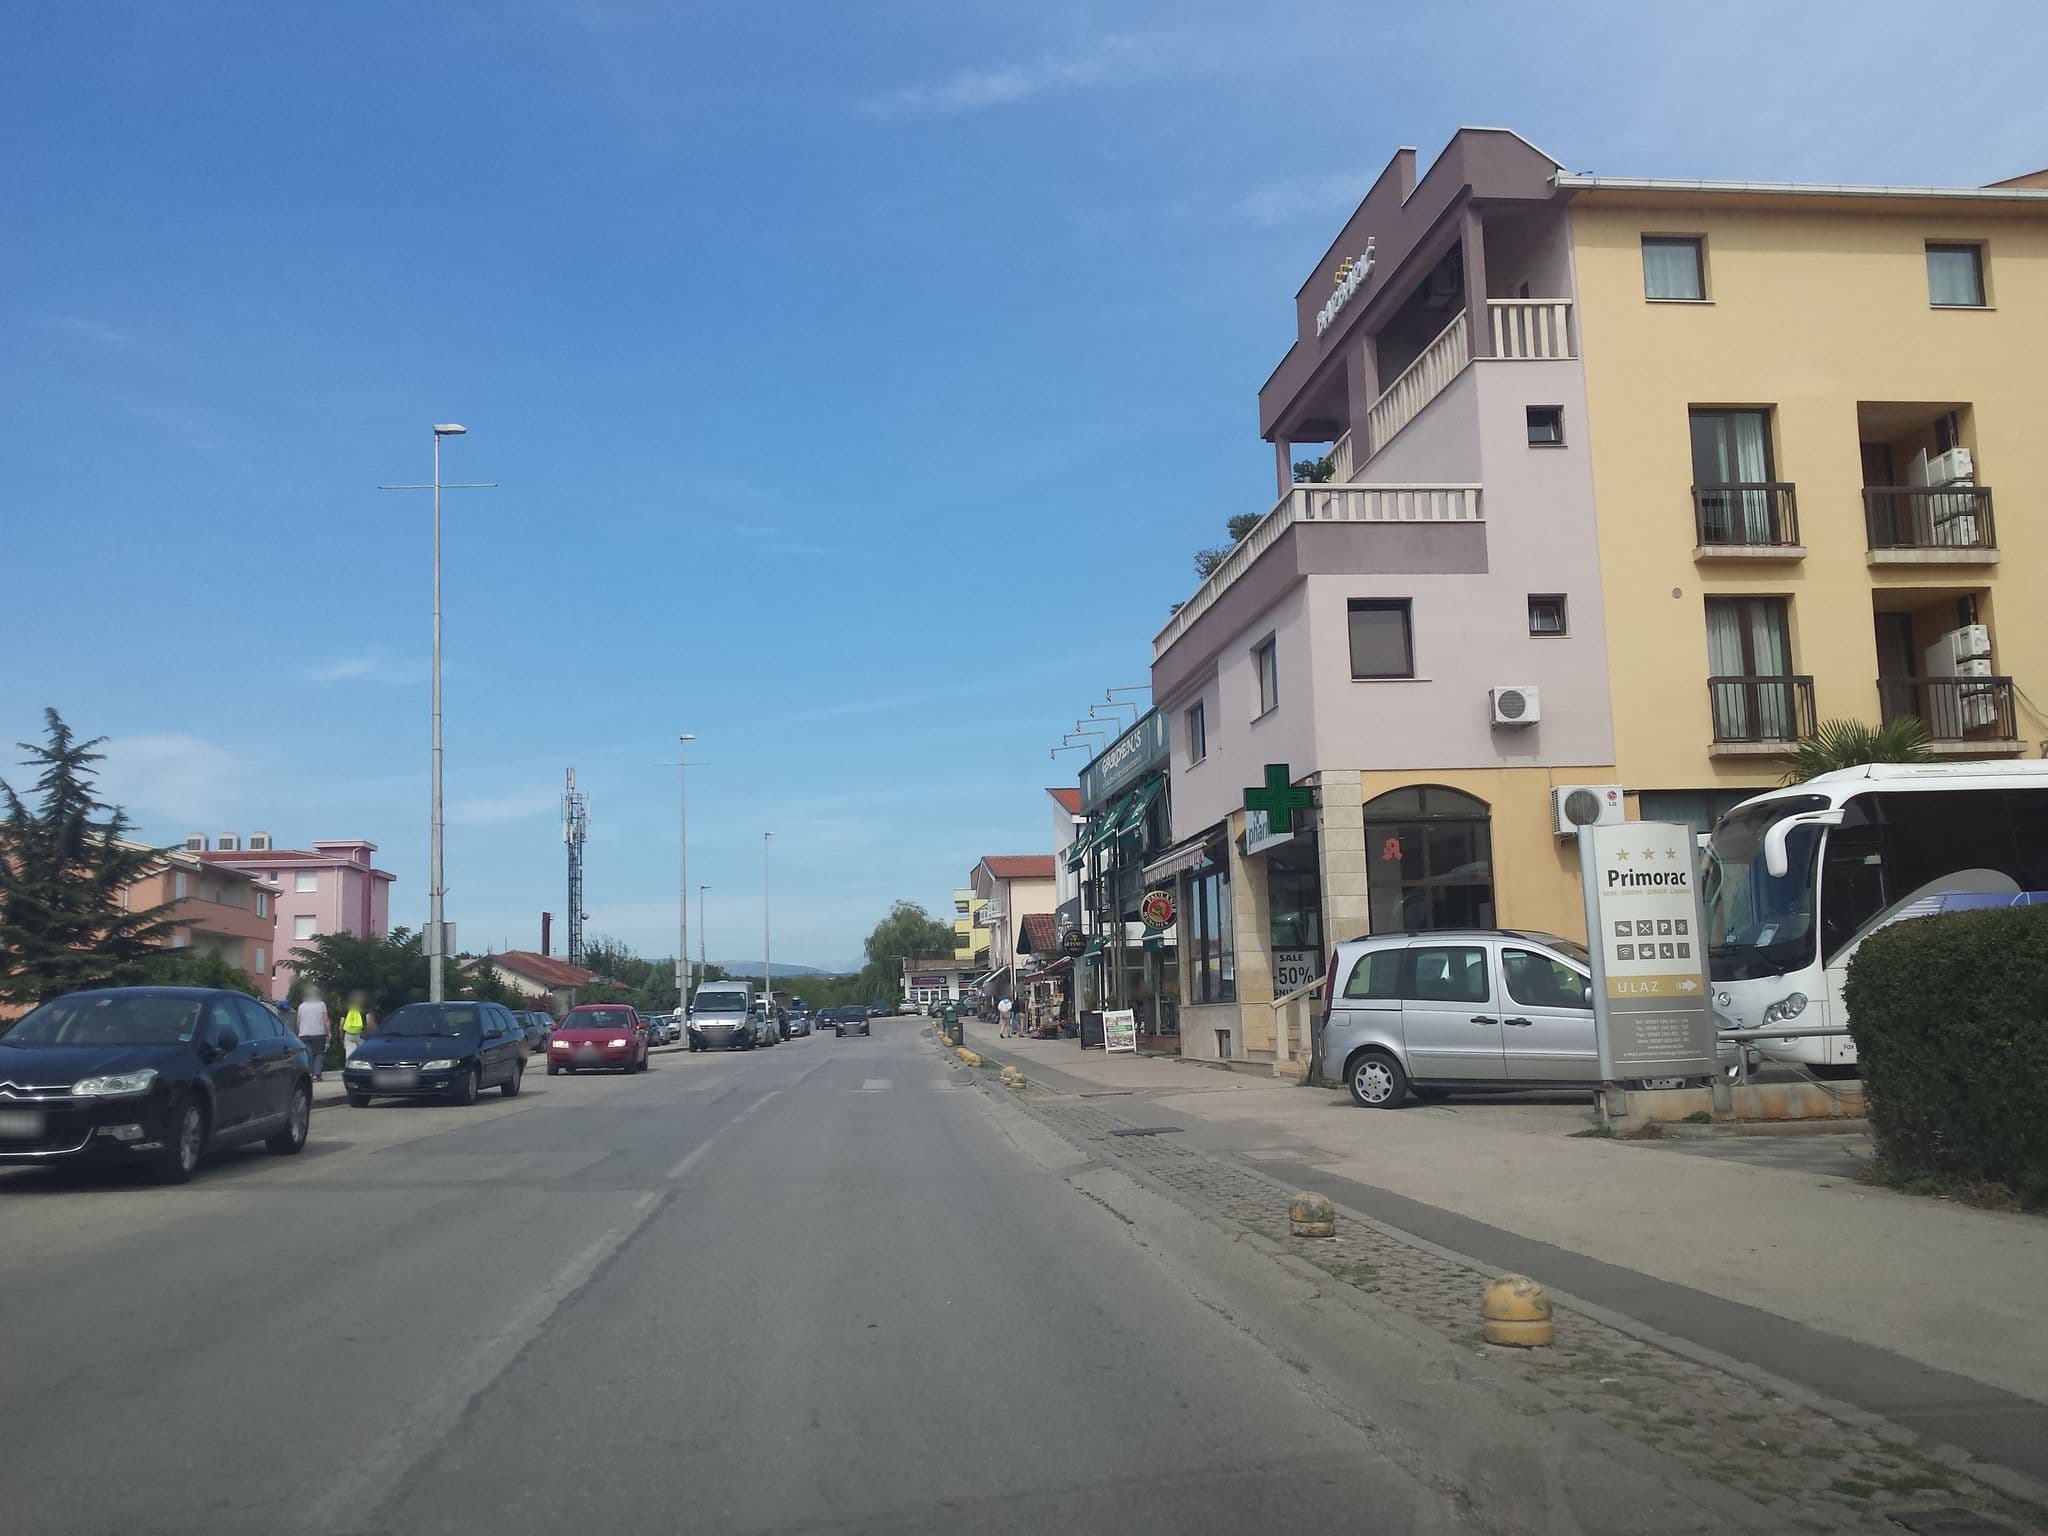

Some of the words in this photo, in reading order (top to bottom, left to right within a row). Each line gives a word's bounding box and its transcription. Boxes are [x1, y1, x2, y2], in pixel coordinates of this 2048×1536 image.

[1607, 868, 1687, 887] Primorac
[1280, 953, 1304, 962] SALE
[1617, 981, 1659, 993] ULAZ
